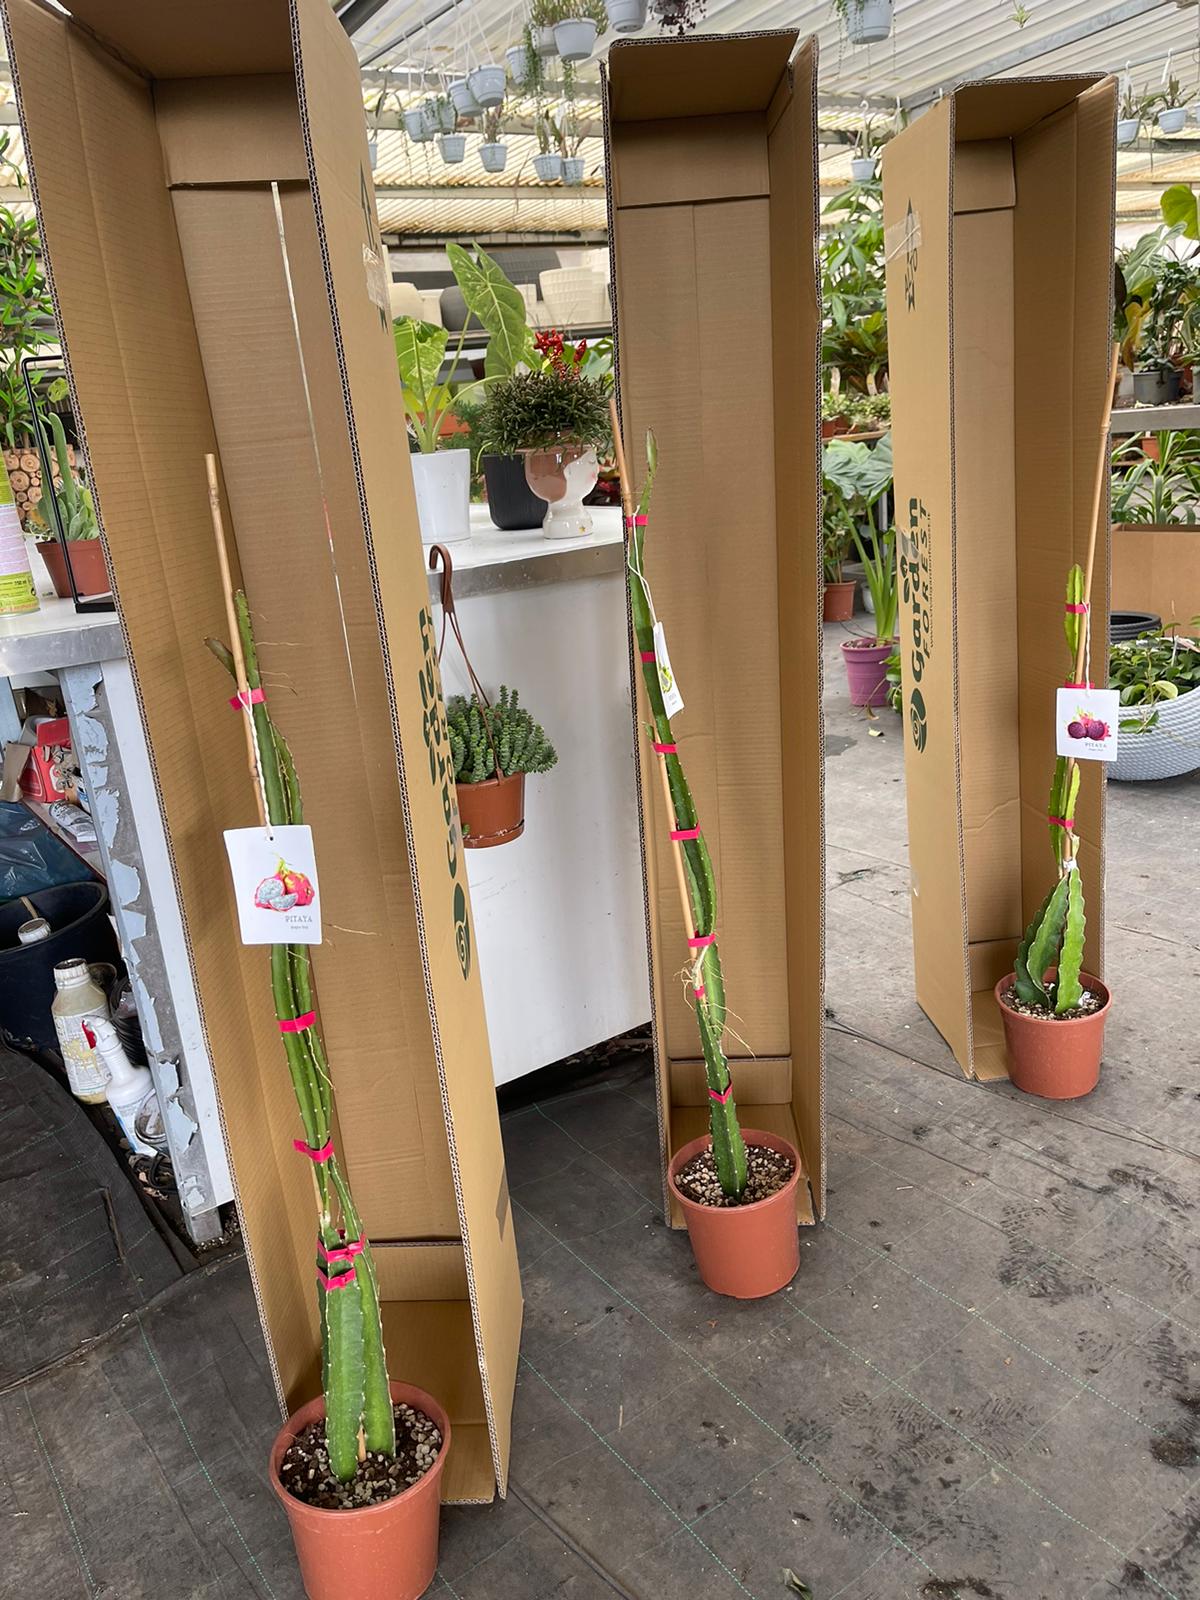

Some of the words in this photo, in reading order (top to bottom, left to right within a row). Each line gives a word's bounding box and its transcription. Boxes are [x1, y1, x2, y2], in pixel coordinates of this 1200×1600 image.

[908, 498, 926, 683] Garden
[918, 499, 931, 660] FOREST
[419, 608, 457, 880] Garden
